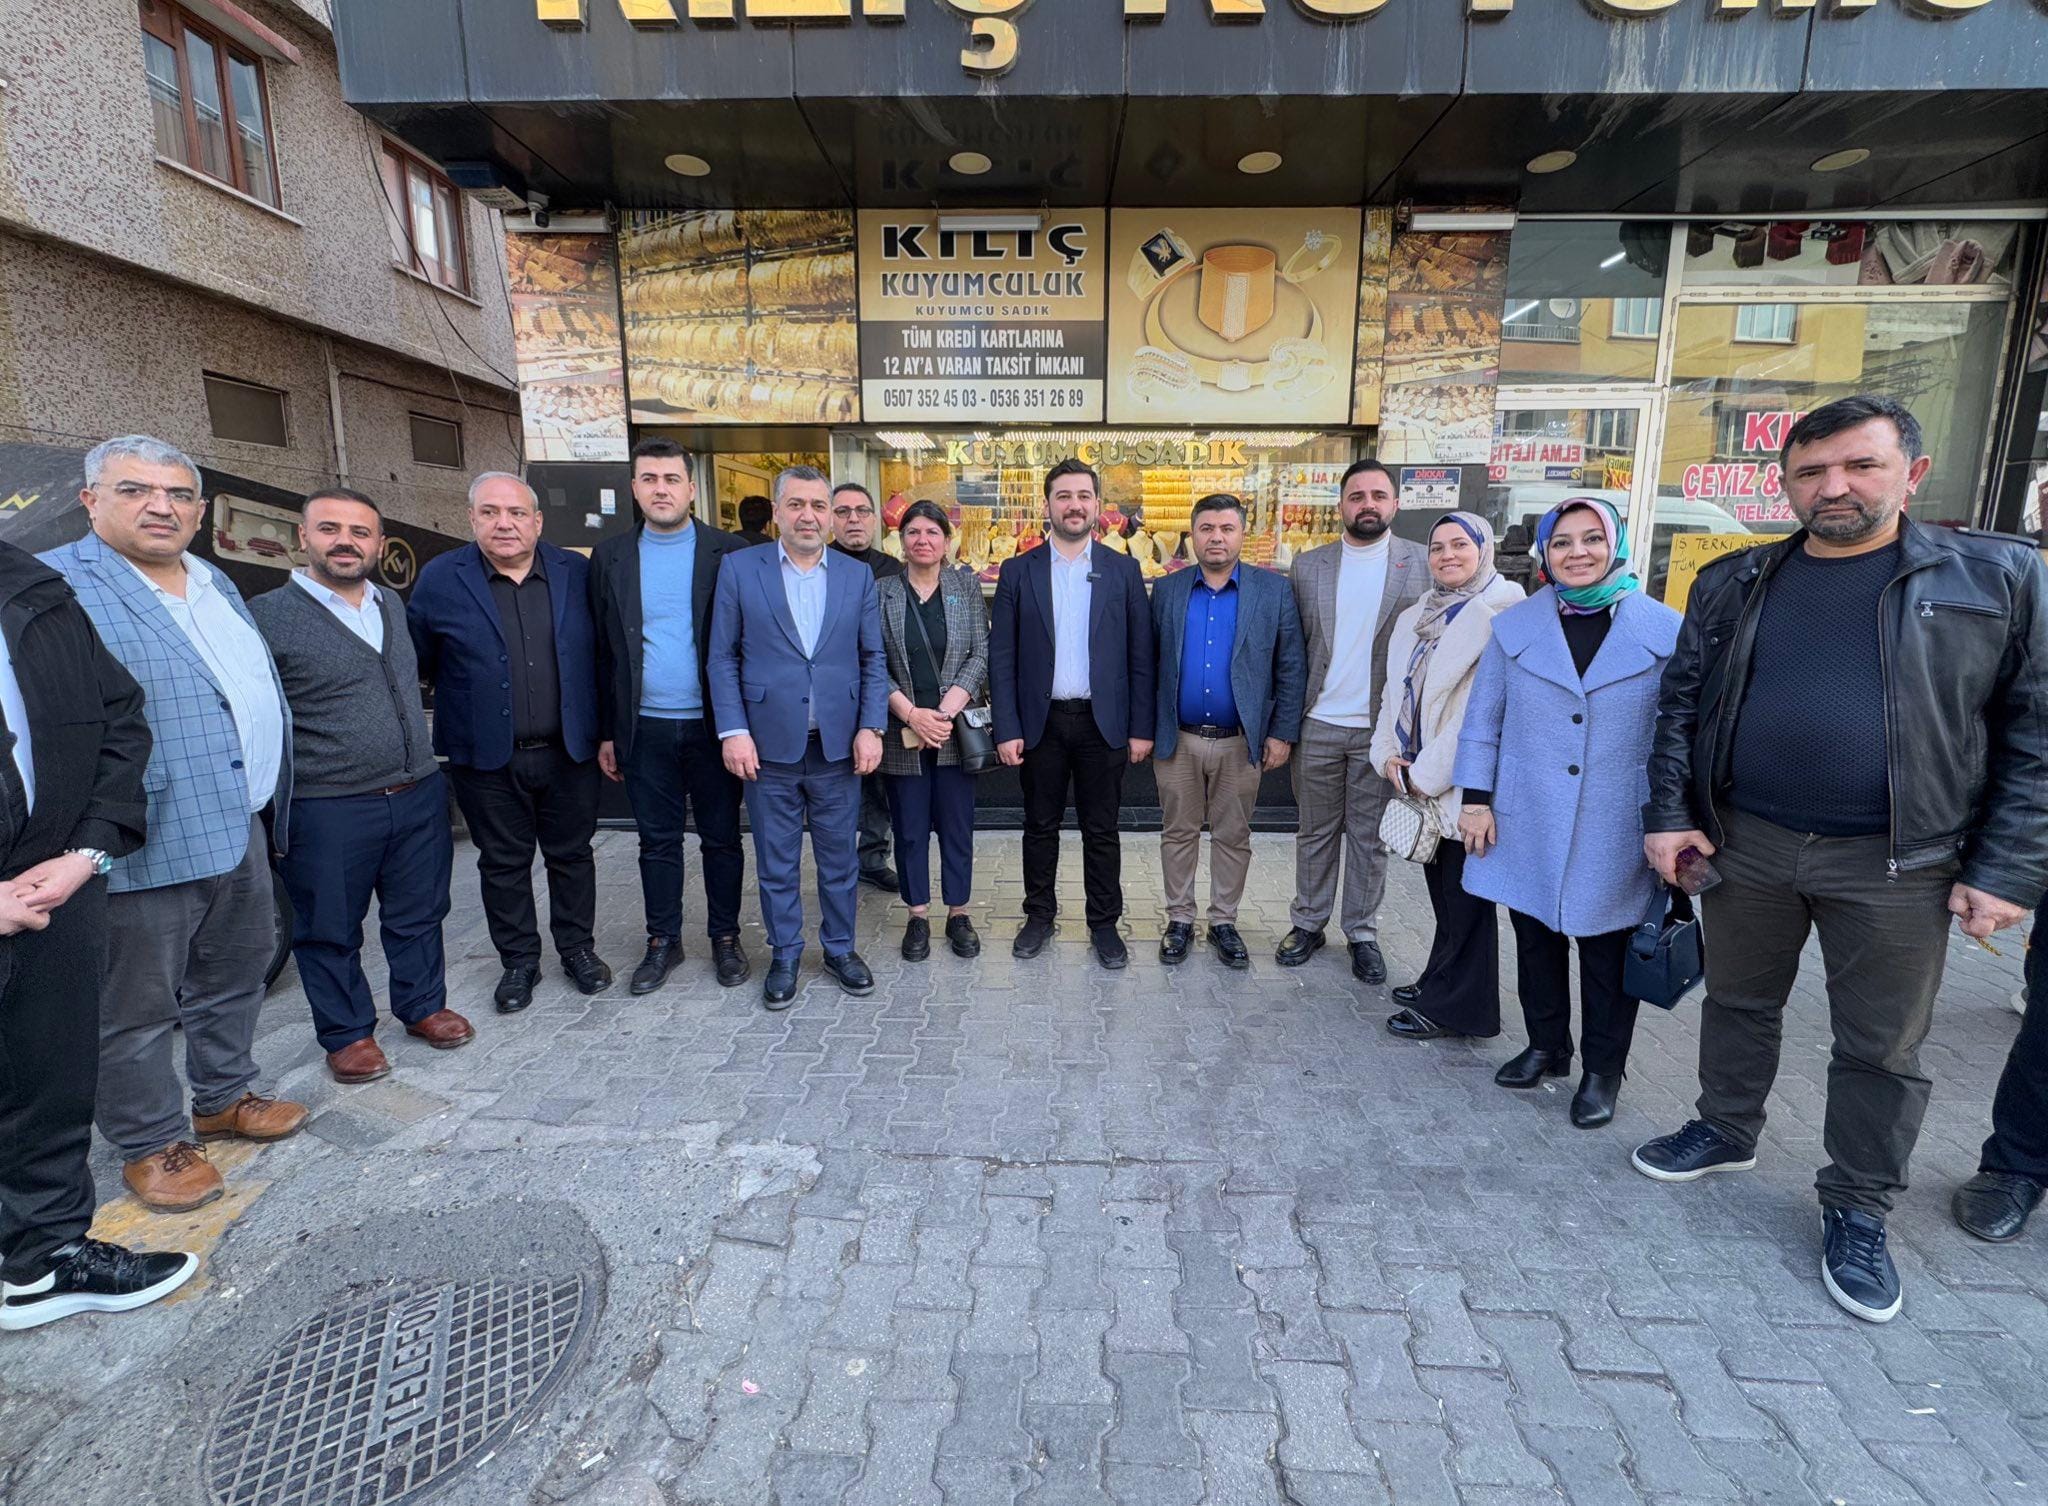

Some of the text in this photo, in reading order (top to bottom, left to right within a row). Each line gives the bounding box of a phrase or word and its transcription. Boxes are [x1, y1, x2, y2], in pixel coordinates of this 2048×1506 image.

[881, 224, 1088, 267] KILIÇ
[881, 271, 1087, 299] KUYUMCULUK
[915, 305, 1050, 316] KUYUMCU SADIK
[902, 325, 1064, 348] TÜM KREDİ KARTLARINA
[883, 352, 1084, 375] 12 AY'A VARAN TAKSİT İMKANI
[884, 389, 913, 408] 0507
[917, 389, 940, 408] 352
[943, 389, 958, 408] 45
[962, 389, 977, 408] 03
[990, 389, 1019, 408] 0536
[1024, 389, 1045, 408] 351
[1050, 389, 1065, 408] 26
[1069, 389, 1084, 408] 89
[1743, 412, 1809, 451] KI
[945, 440, 1248, 466] KUYUMCU SADIK
[1415, 469, 1446, 478] DİKKAT
[1761, 463, 1782, 497] &
[381, 1292, 439, 1434] TELEFON
